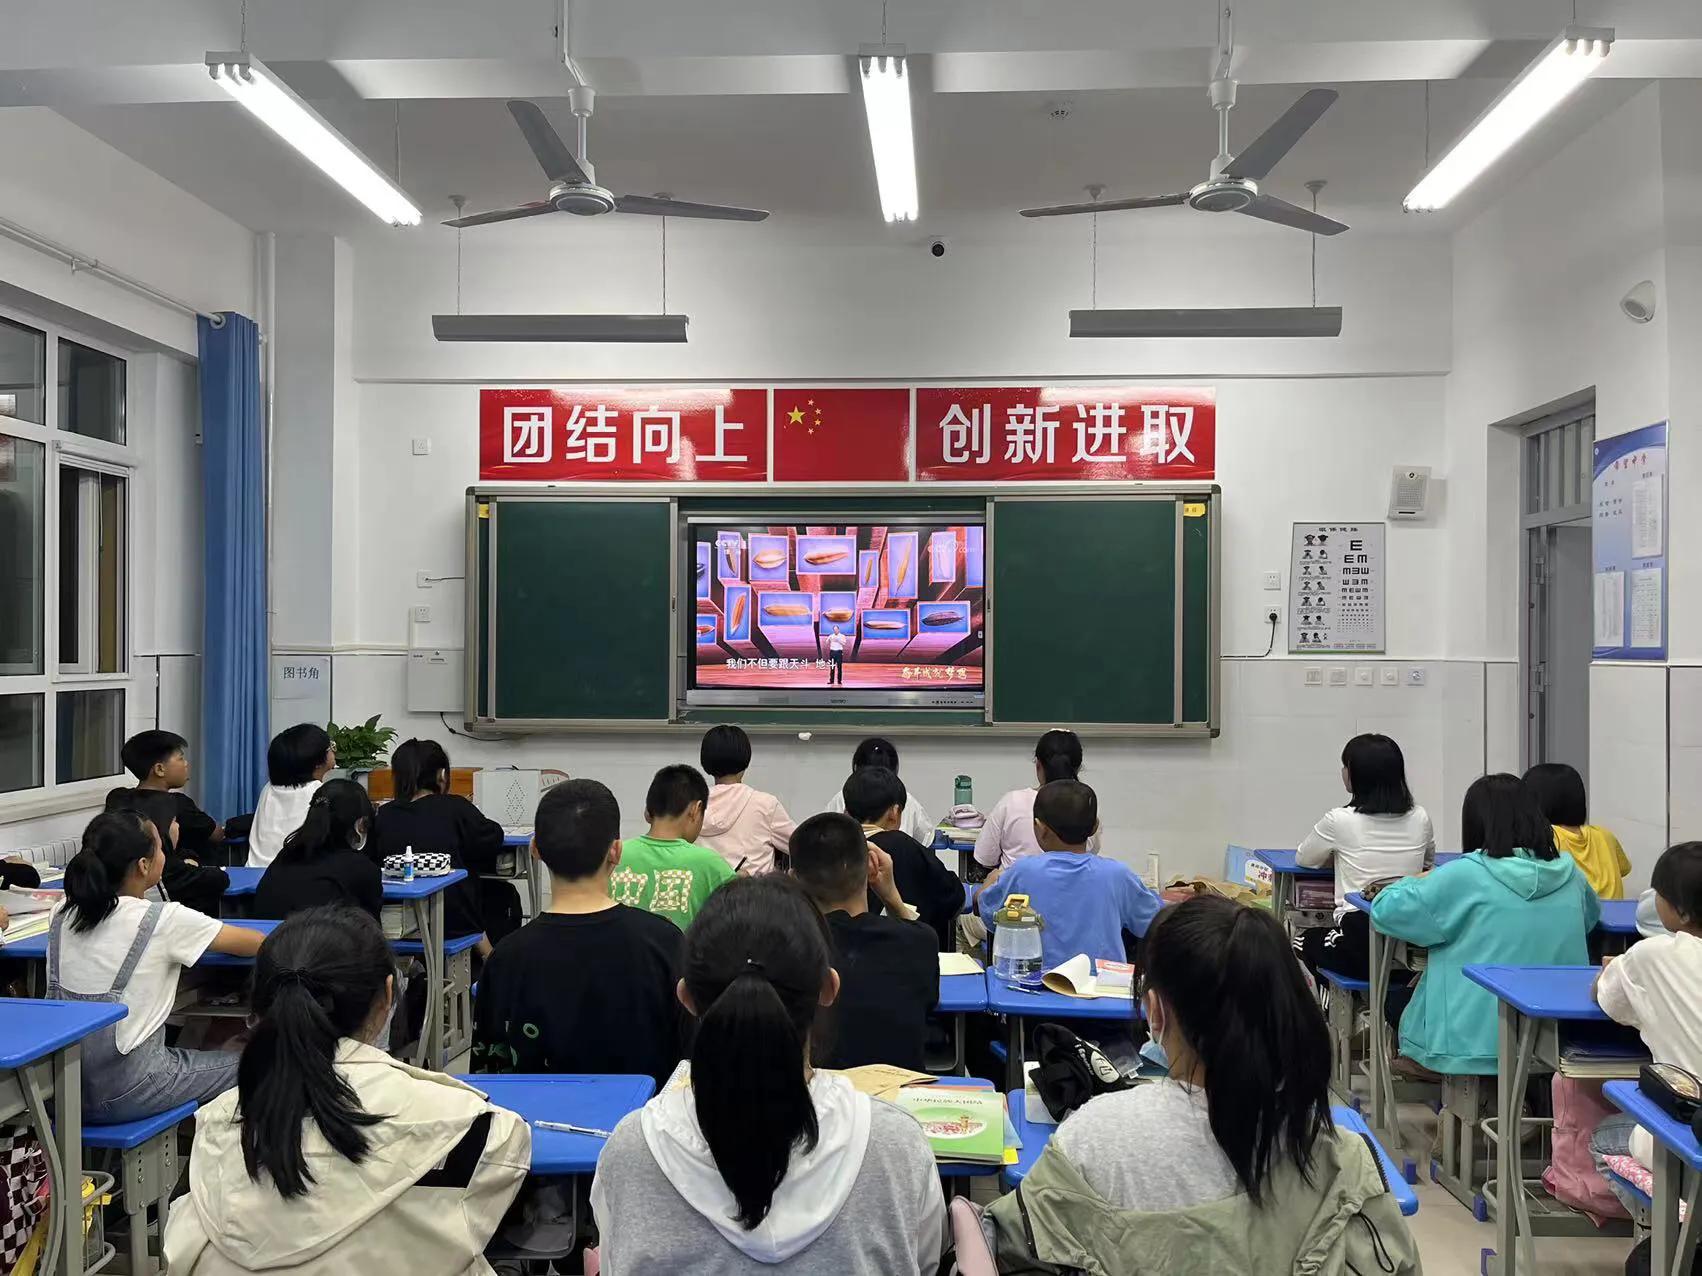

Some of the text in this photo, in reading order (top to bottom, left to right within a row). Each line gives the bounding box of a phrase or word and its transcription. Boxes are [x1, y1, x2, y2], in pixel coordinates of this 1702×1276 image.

[502, 405, 748, 464] 团结向上
[939, 403, 1197, 464] 创新进取
[283, 666, 320, 680] 图书角
[725, 657, 838, 671] 我们不但要跟天斗 地斗
[610, 864, 693, 914] 中国
